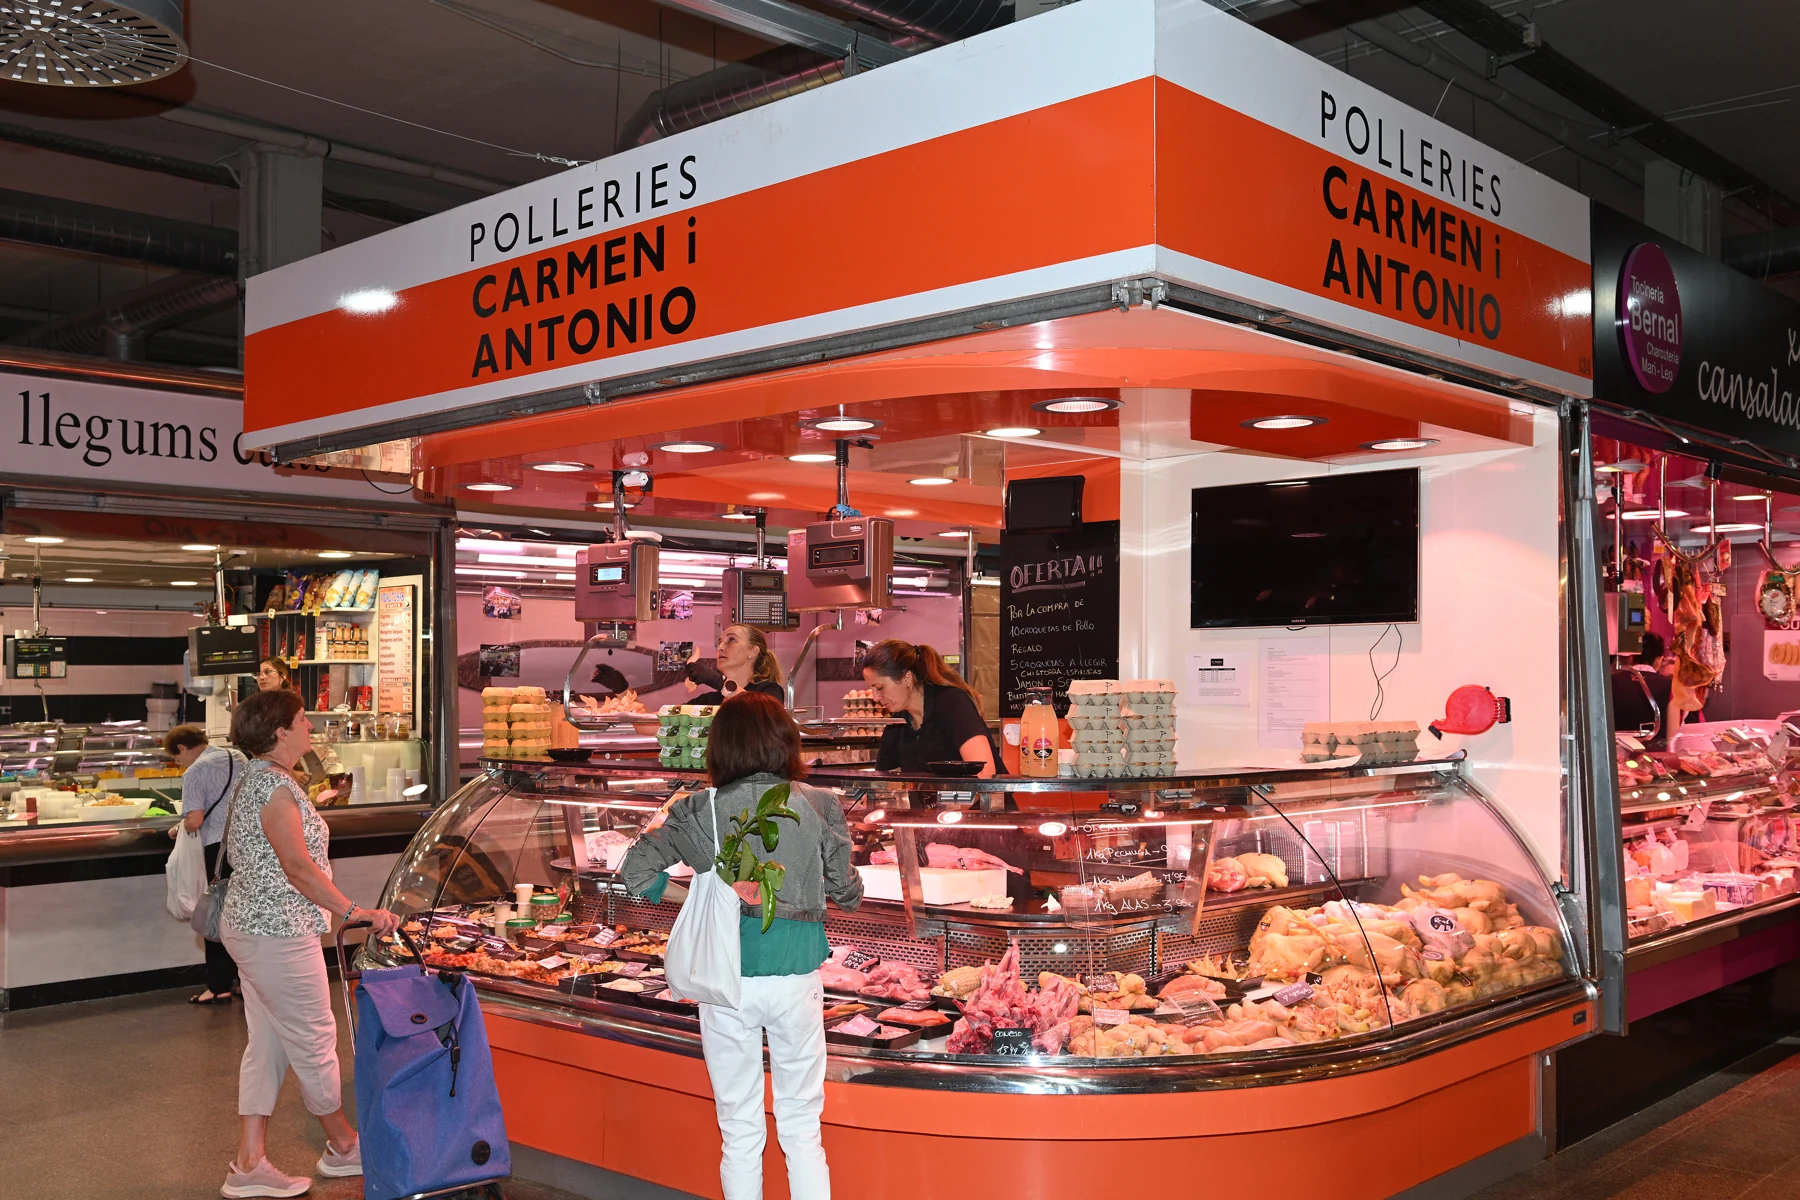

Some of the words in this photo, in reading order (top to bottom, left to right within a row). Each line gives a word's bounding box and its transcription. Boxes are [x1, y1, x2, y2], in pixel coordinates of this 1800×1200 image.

[1320, 90, 1502, 218] POLLERIES
[470, 155, 697, 262] POLLERIES
[1322, 165, 1482, 272] CARMEN
[1493, 234, 1501, 280] i
[472, 225, 665, 318] CARMEN
[687, 216, 696, 264] i
[1322, 238, 1502, 341] ANTONIO
[471, 286, 696, 378] ANTONIO
[1631, 297, 1679, 345] Bernal
[18, 390, 218, 467] llegums
[1037, 602, 1069, 614] COMPRA
[1074, 598, 1084, 608] DE
[1062, 624, 1072, 632] DE
[1010, 659, 1019, 671] 5
[1019, 659, 1065, 669] CROQUETAS
[1069, 659, 1076, 667] A
[1011, 643, 1043, 654] REGALO
